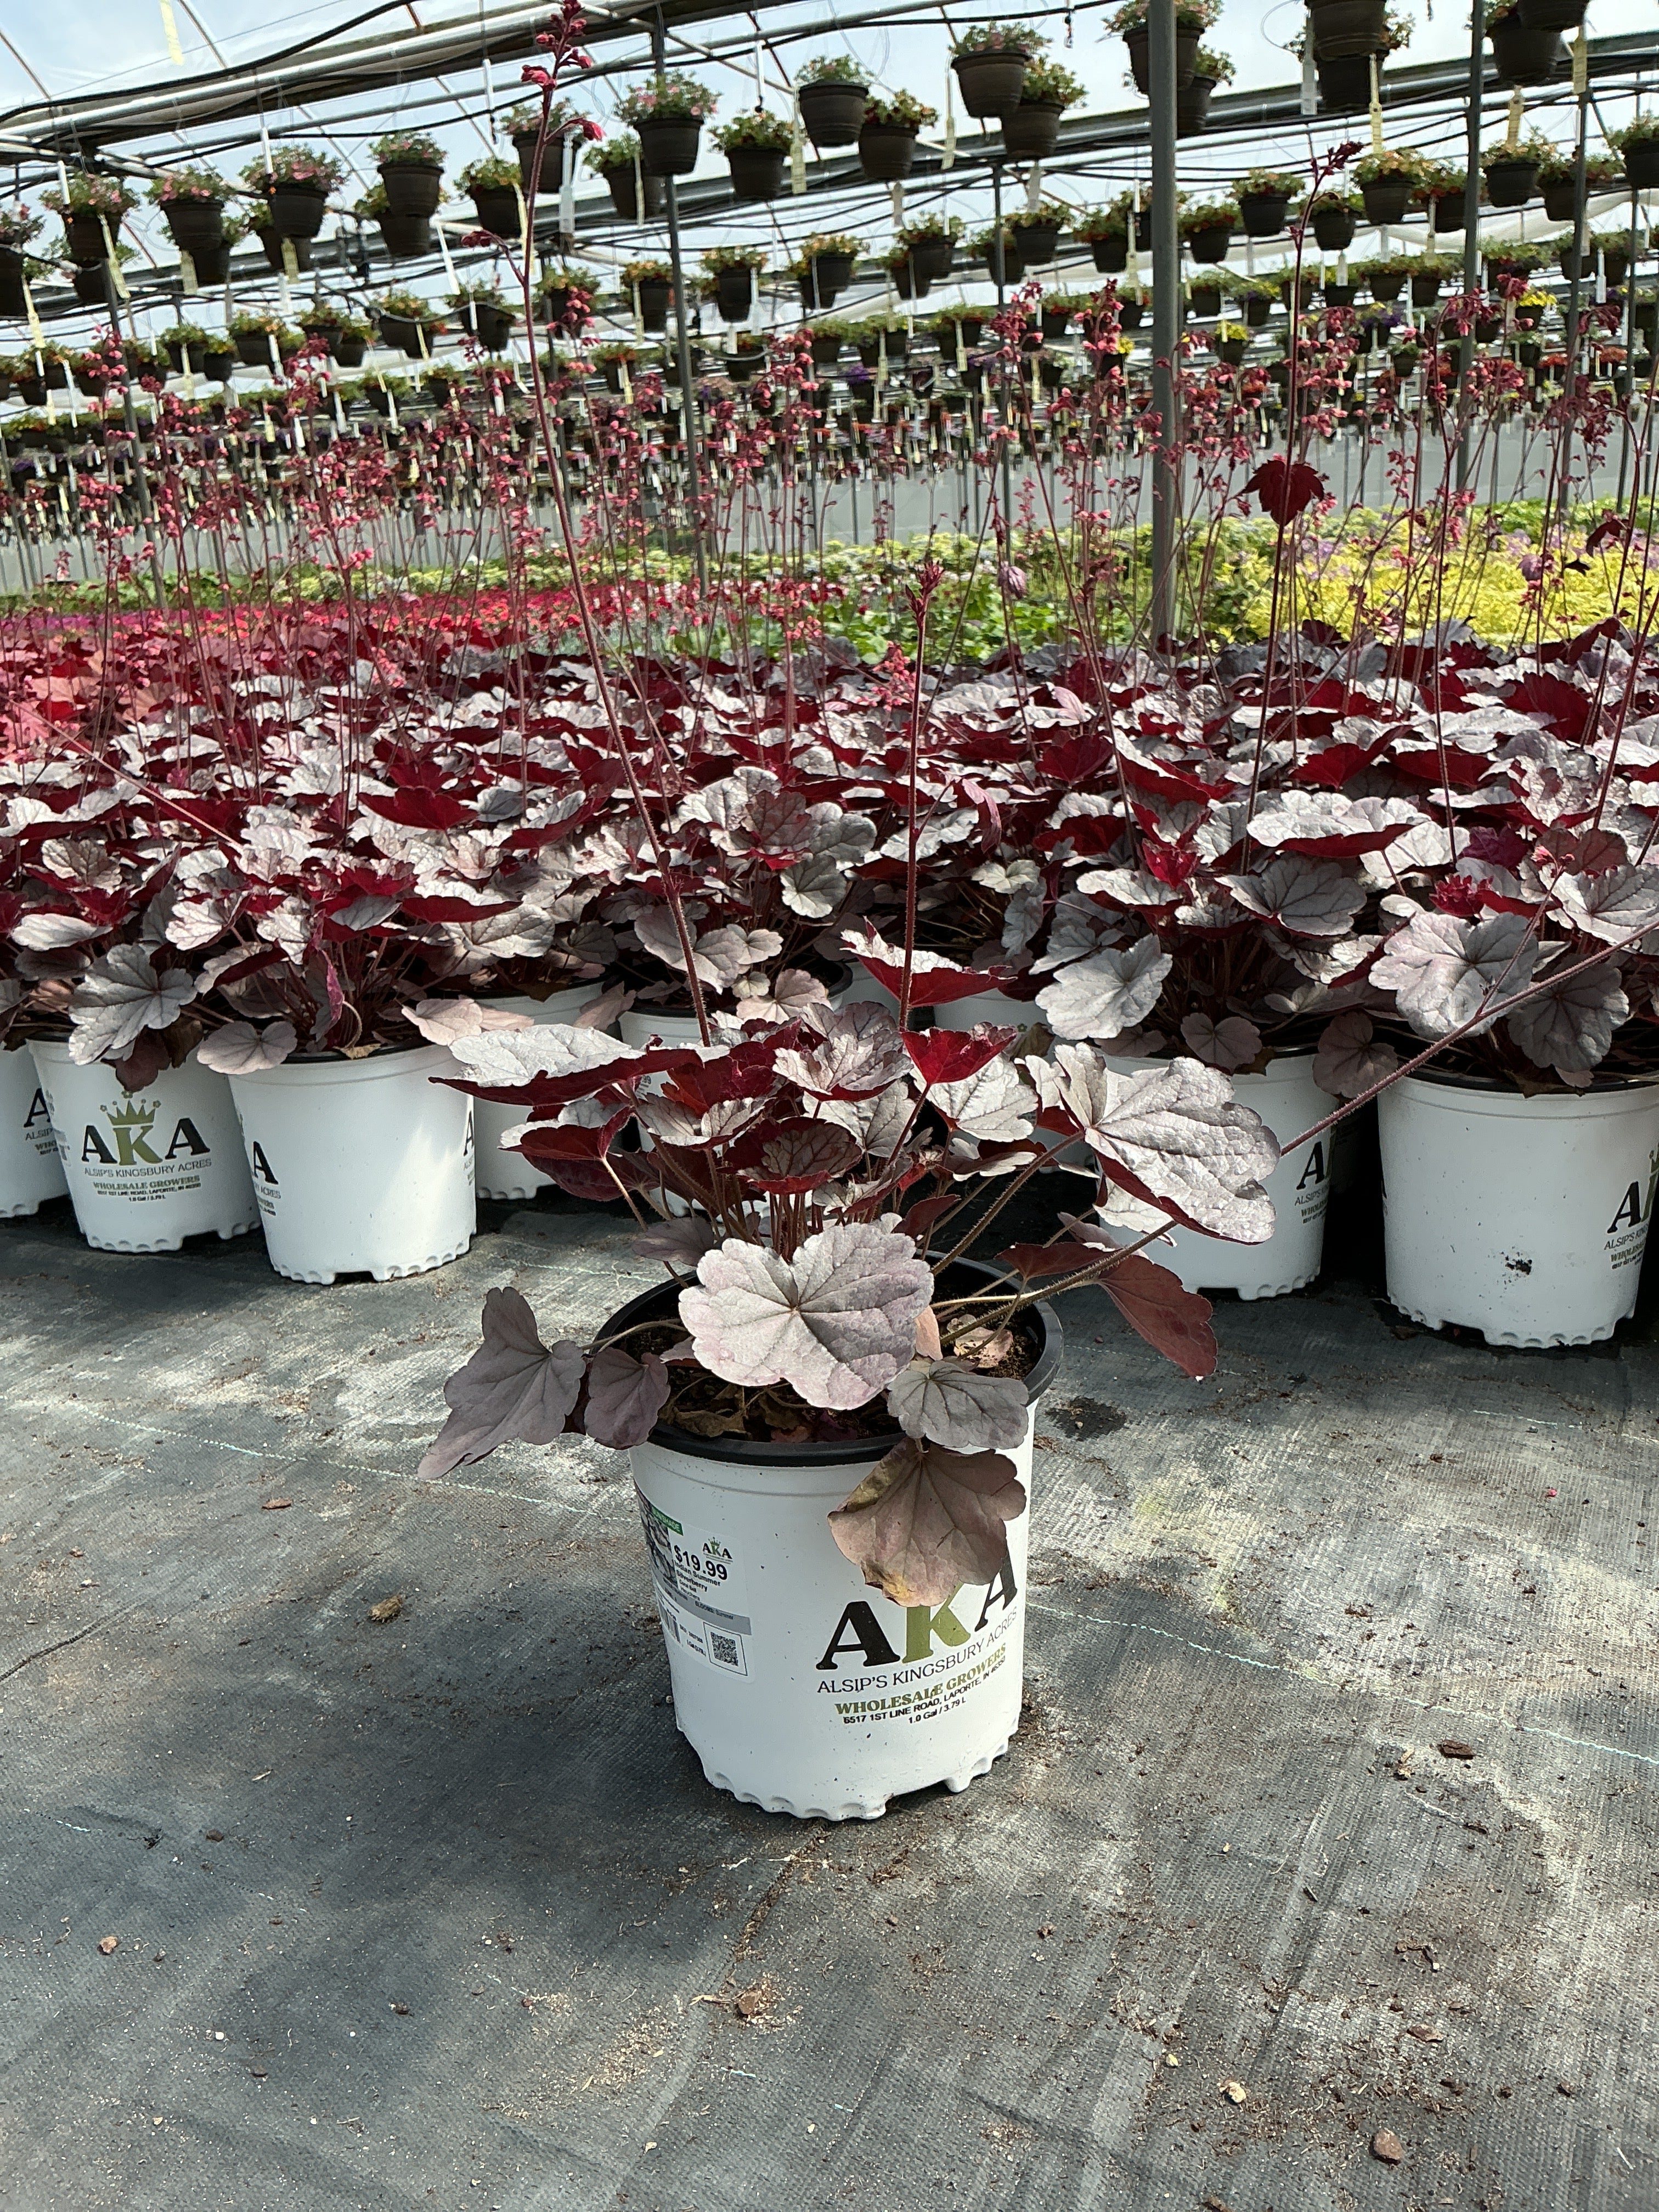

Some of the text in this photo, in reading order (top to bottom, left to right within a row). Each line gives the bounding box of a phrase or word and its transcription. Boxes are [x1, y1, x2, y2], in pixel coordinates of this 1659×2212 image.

[81, 1118, 211, 1166] AKA
[93, 1181, 148, 1190] WHOLESALE
[149, 1175, 200, 1189] GROWERS
[115, 1164, 175, 1178] KINGSBURY
[178, 1158, 212, 1172] ACRES
[674, 1544, 728, 1581] $19.99
[692, 1570, 721, 1587] Summer
[817, 1606, 1017, 1694] ALSIP'S KINGSBURY ACRES
[834, 1642, 1006, 1714] WHOLESALE GROWERS
[870, 1711, 888, 1722] 1ST
[889, 1706, 911, 1718] LINE
[983, 1670, 990, 1680] IN
[908, 1714, 921, 1724] 1.0
[923, 1708, 938, 1719] Gal
[943, 1699, 960, 1712] 3.79
